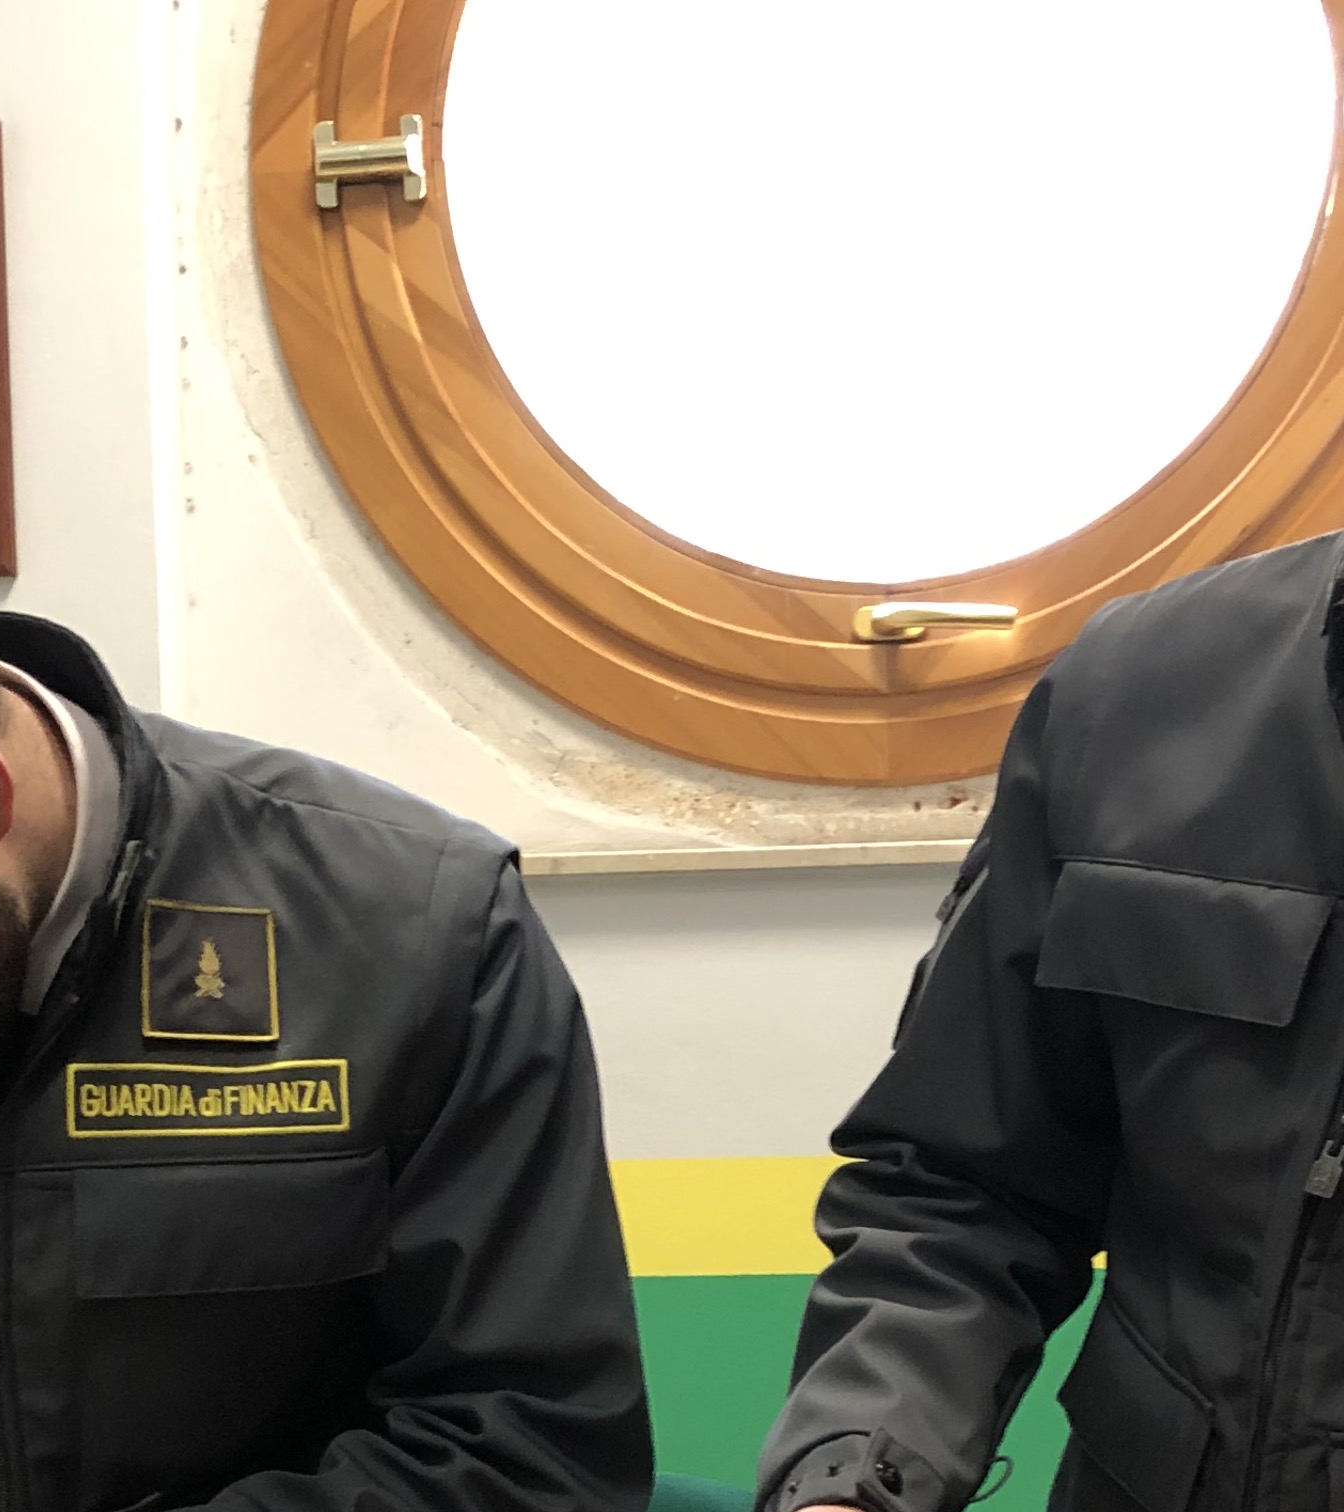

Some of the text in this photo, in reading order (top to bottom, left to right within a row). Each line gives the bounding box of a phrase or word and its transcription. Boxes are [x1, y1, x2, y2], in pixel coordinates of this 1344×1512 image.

[79, 1080, 337, 1118] GUARDIA di FINANZA
